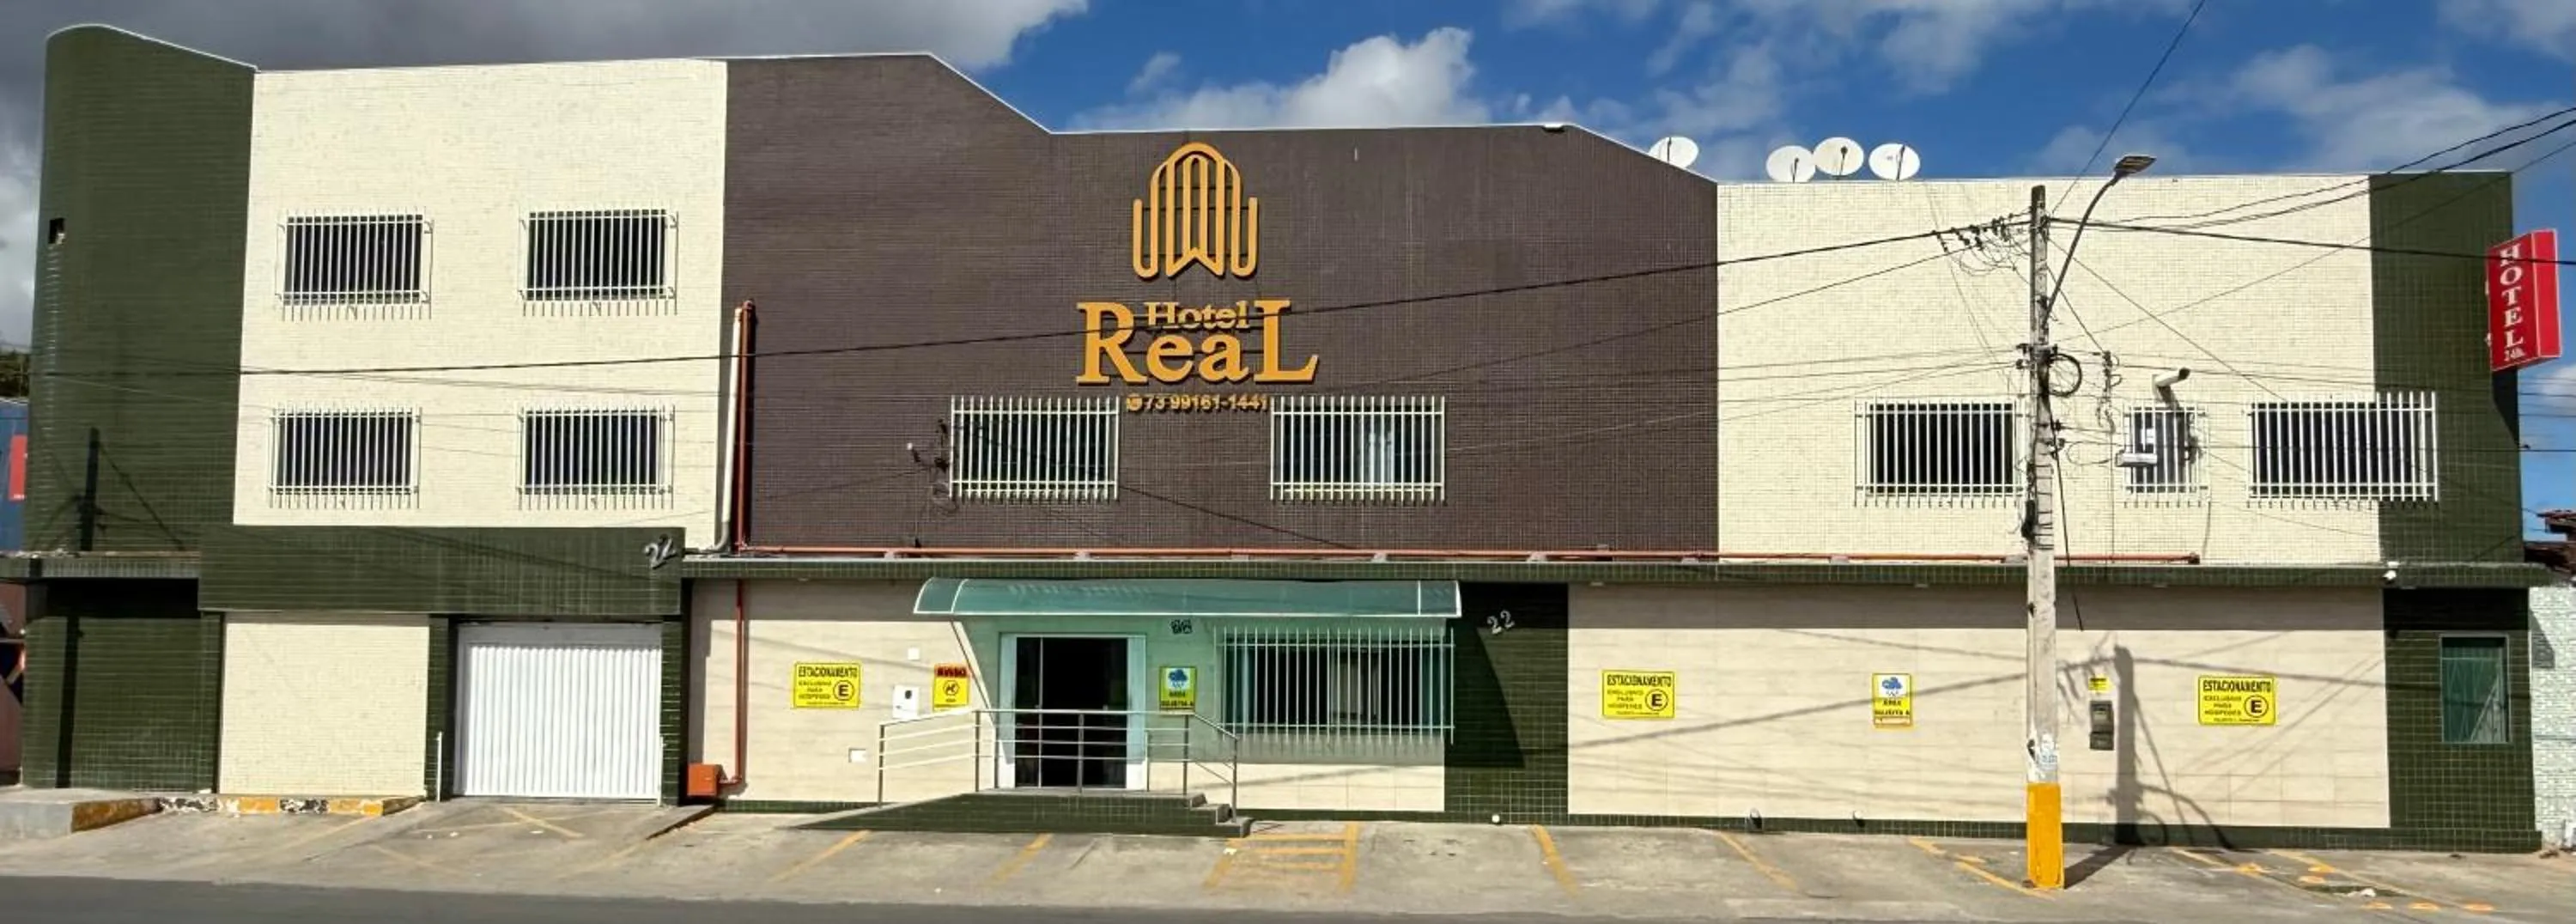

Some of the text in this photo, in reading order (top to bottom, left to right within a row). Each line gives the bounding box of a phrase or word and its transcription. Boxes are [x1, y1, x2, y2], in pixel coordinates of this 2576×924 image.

[2499, 243, 2524, 349] HOTEL
[1144, 301, 1250, 328] Hotel
[1487, 610, 1515, 634] 22
[838, 684, 849, 696] E
[1651, 693, 1663, 707] E
[2251, 700, 2263, 714] E
